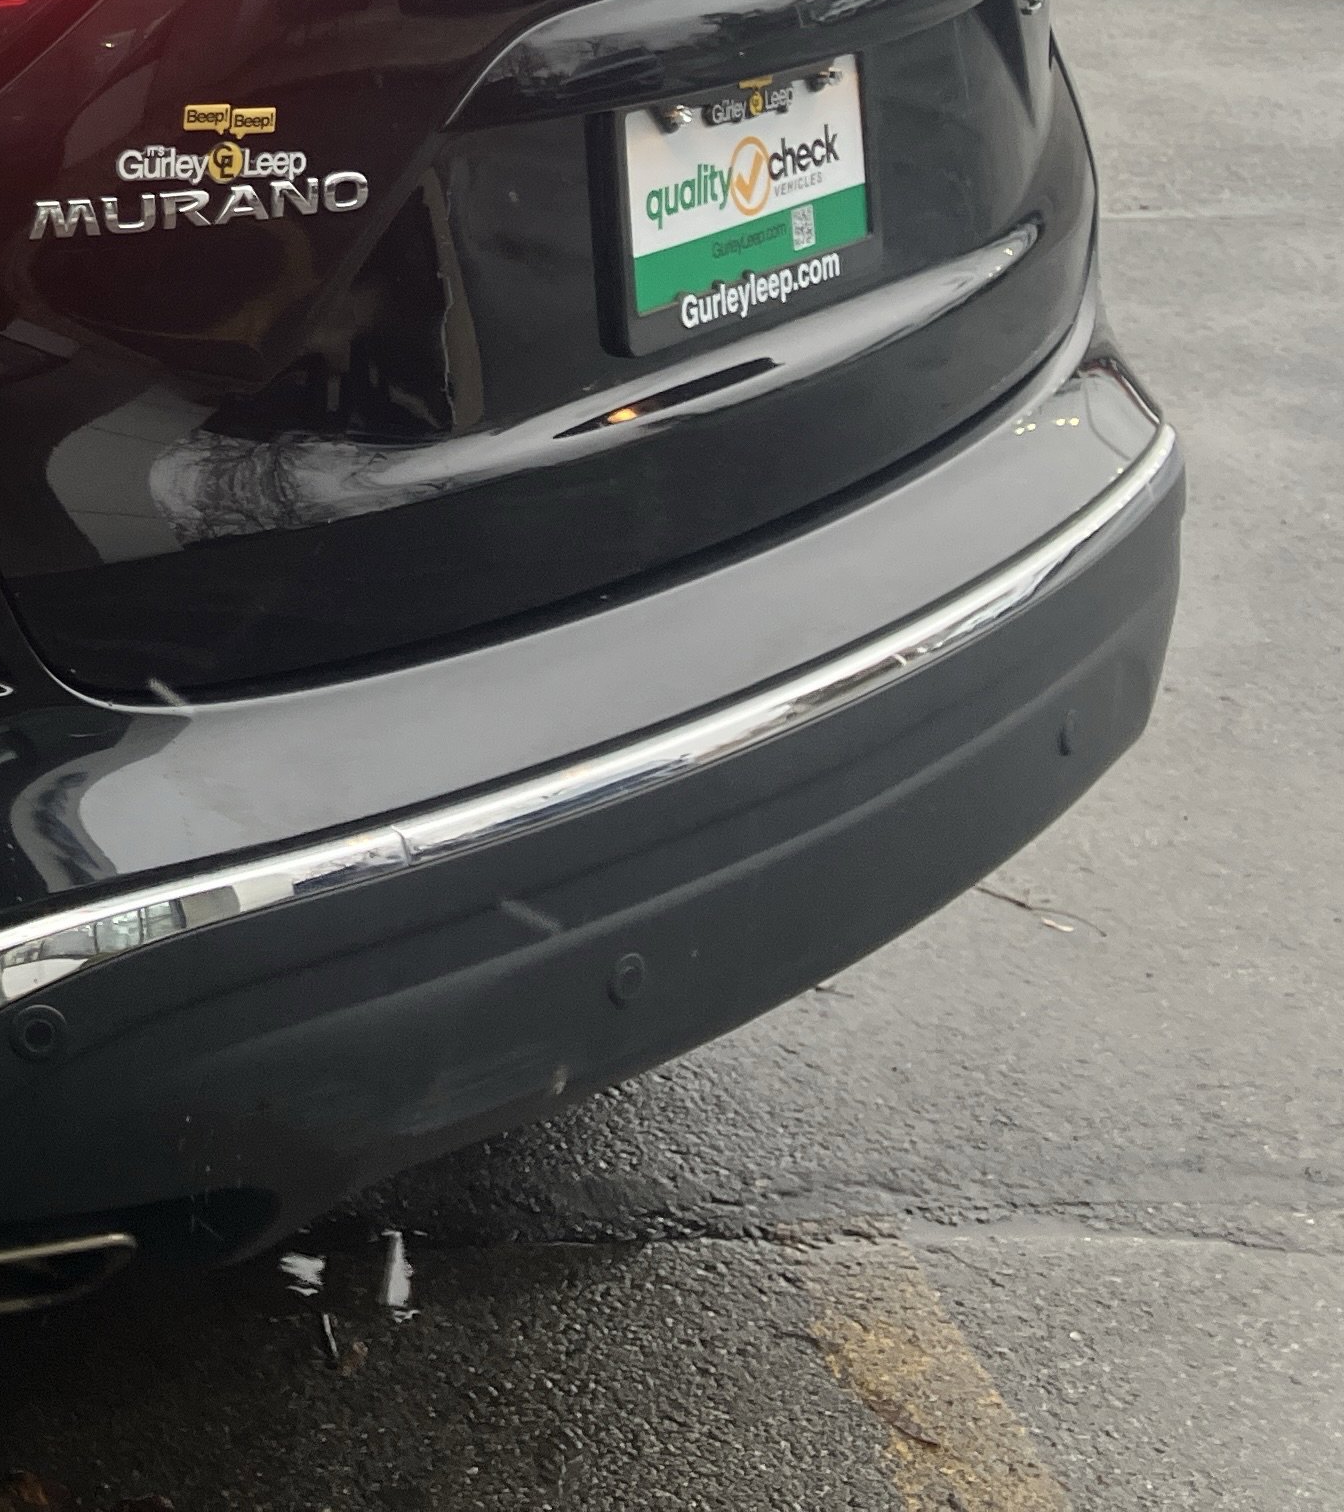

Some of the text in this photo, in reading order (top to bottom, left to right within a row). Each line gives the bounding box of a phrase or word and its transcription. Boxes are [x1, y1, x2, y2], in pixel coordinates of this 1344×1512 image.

[764, 87, 794, 110] Leep
[187, 109, 274, 129] Beep! Beep!
[118, 146, 210, 185] Gurley
[242, 151, 307, 180] Leep
[646, 124, 840, 230] quality check
[774, 171, 823, 197] VEHICLES
[29, 171, 368, 240] MURANO
[681, 252, 840, 328] Gurleyleep.com
